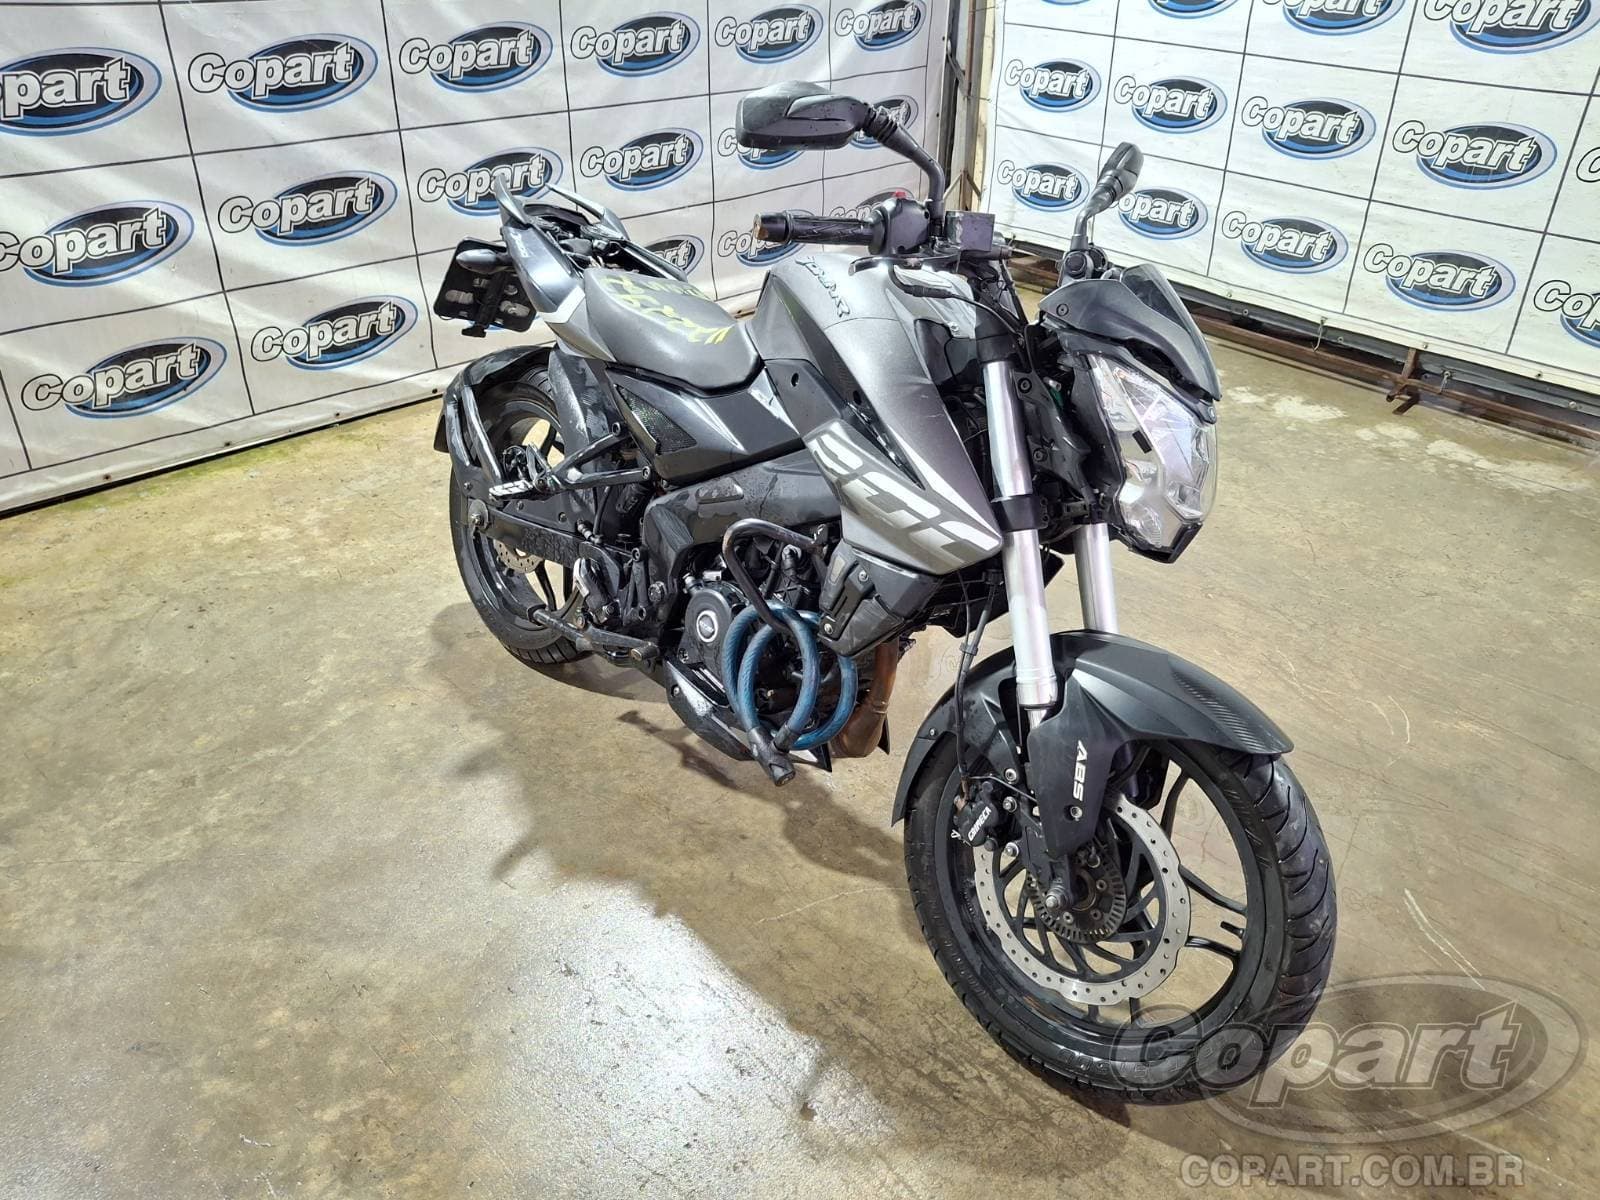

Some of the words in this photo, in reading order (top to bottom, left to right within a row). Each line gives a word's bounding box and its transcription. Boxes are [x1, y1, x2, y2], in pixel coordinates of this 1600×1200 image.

[570, 19, 685, 65] Copart
[714, 11, 811, 51] Copart
[835, 2, 917, 40] Copart
[188, 41, 356, 99] Copart
[400, 30, 534, 80] Copart
[1004, 59, 1090, 99] Copart
[0, 57, 131, 119] part
[1114, 75, 1214, 119] Copart
[1241, 96, 1361, 145] Copart
[580, 133, 690, 181] Copart
[1393, 120, 1538, 173] Copart
[997, 160, 1079, 200] Copart
[218, 177, 376, 235] Copart
[1109, 192, 1195, 229] opart
[1222, 210, 1335, 262] Copart
[1363, 243, 1501, 297] Copart
[251, 299, 398, 361] Copart
[21, 341, 201, 410] Copart
[1073, 740, 1088, 801] ABS
